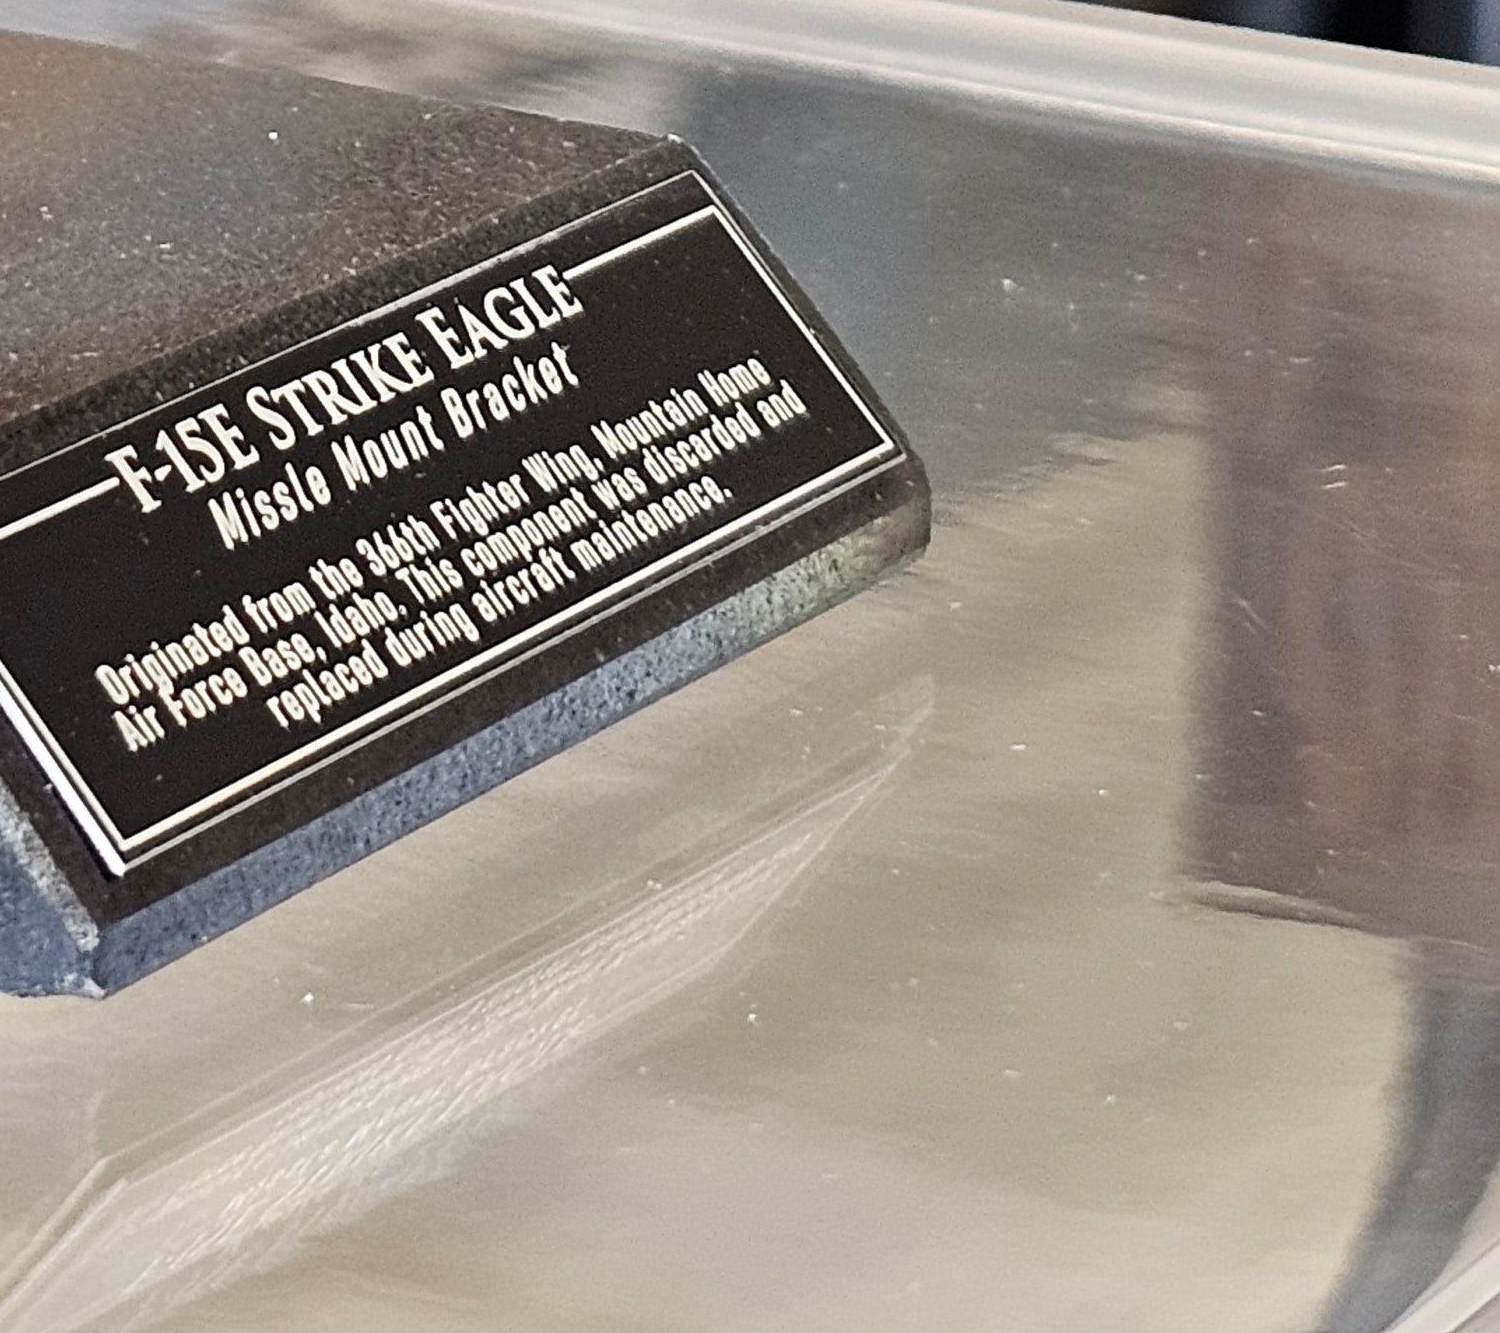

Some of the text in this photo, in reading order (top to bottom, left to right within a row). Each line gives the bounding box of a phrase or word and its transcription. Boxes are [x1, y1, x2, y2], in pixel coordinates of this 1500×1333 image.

[105, 265, 584, 513] F-15E STRIKE EAGLE
[208, 342, 579, 549] Missle Mount Bracket
[95, 357, 771, 705] Originated from the 366th Fighter Wing, Mountain Home
[111, 704, 166, 751] Air
[157, 666, 249, 727] Force
[238, 632, 326, 687] Base,
[395, 557, 464, 604] This
[460, 486, 597, 577] component
[591, 463, 649, 511] was
[642, 402, 763, 485] discarded
[757, 379, 807, 428] and
[265, 474, 733, 729] replaced during aircraft maintenance.
